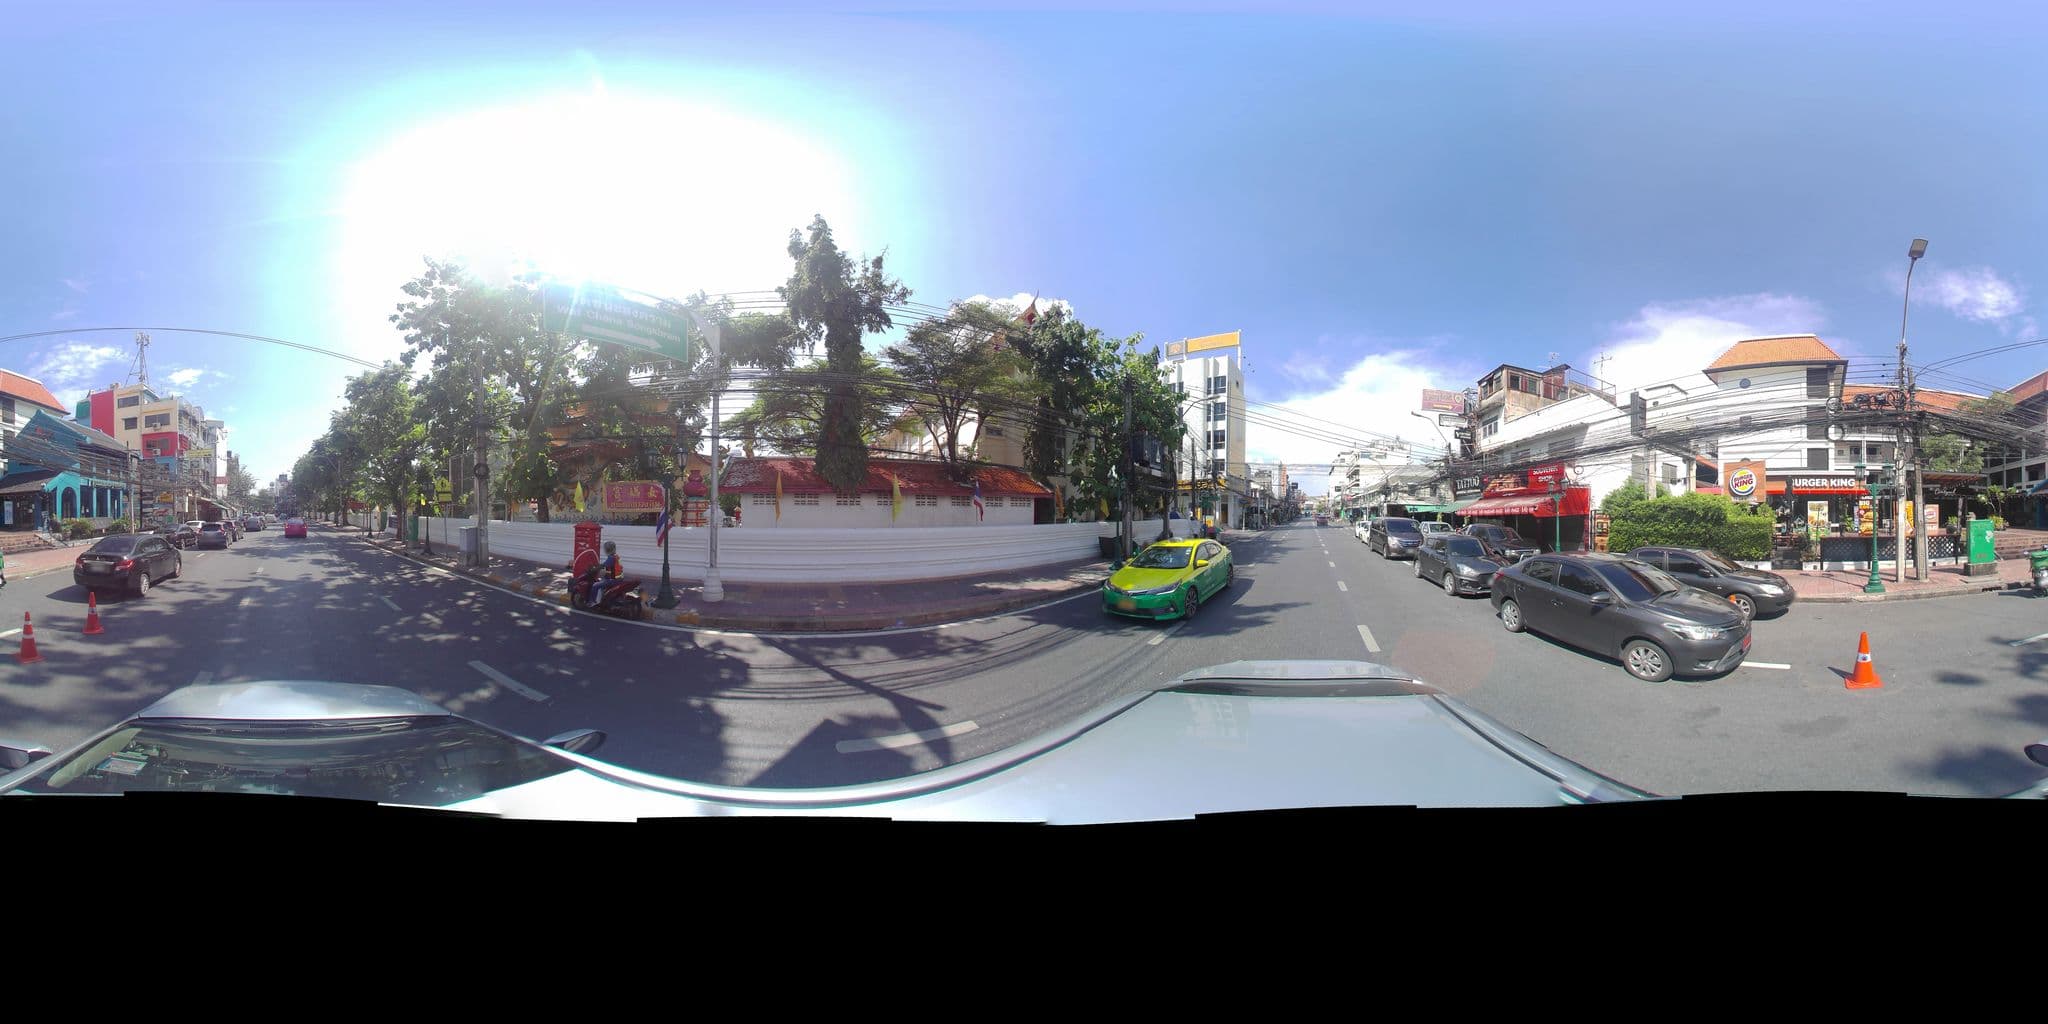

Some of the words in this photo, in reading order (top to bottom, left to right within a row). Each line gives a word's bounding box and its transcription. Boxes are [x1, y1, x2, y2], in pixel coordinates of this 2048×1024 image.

[1457, 476, 1479, 489] TATTOO
[1734, 479, 1753, 488] KING
[1792, 478, 1827, 487] URGER
[1830, 478, 1855, 487] KING
